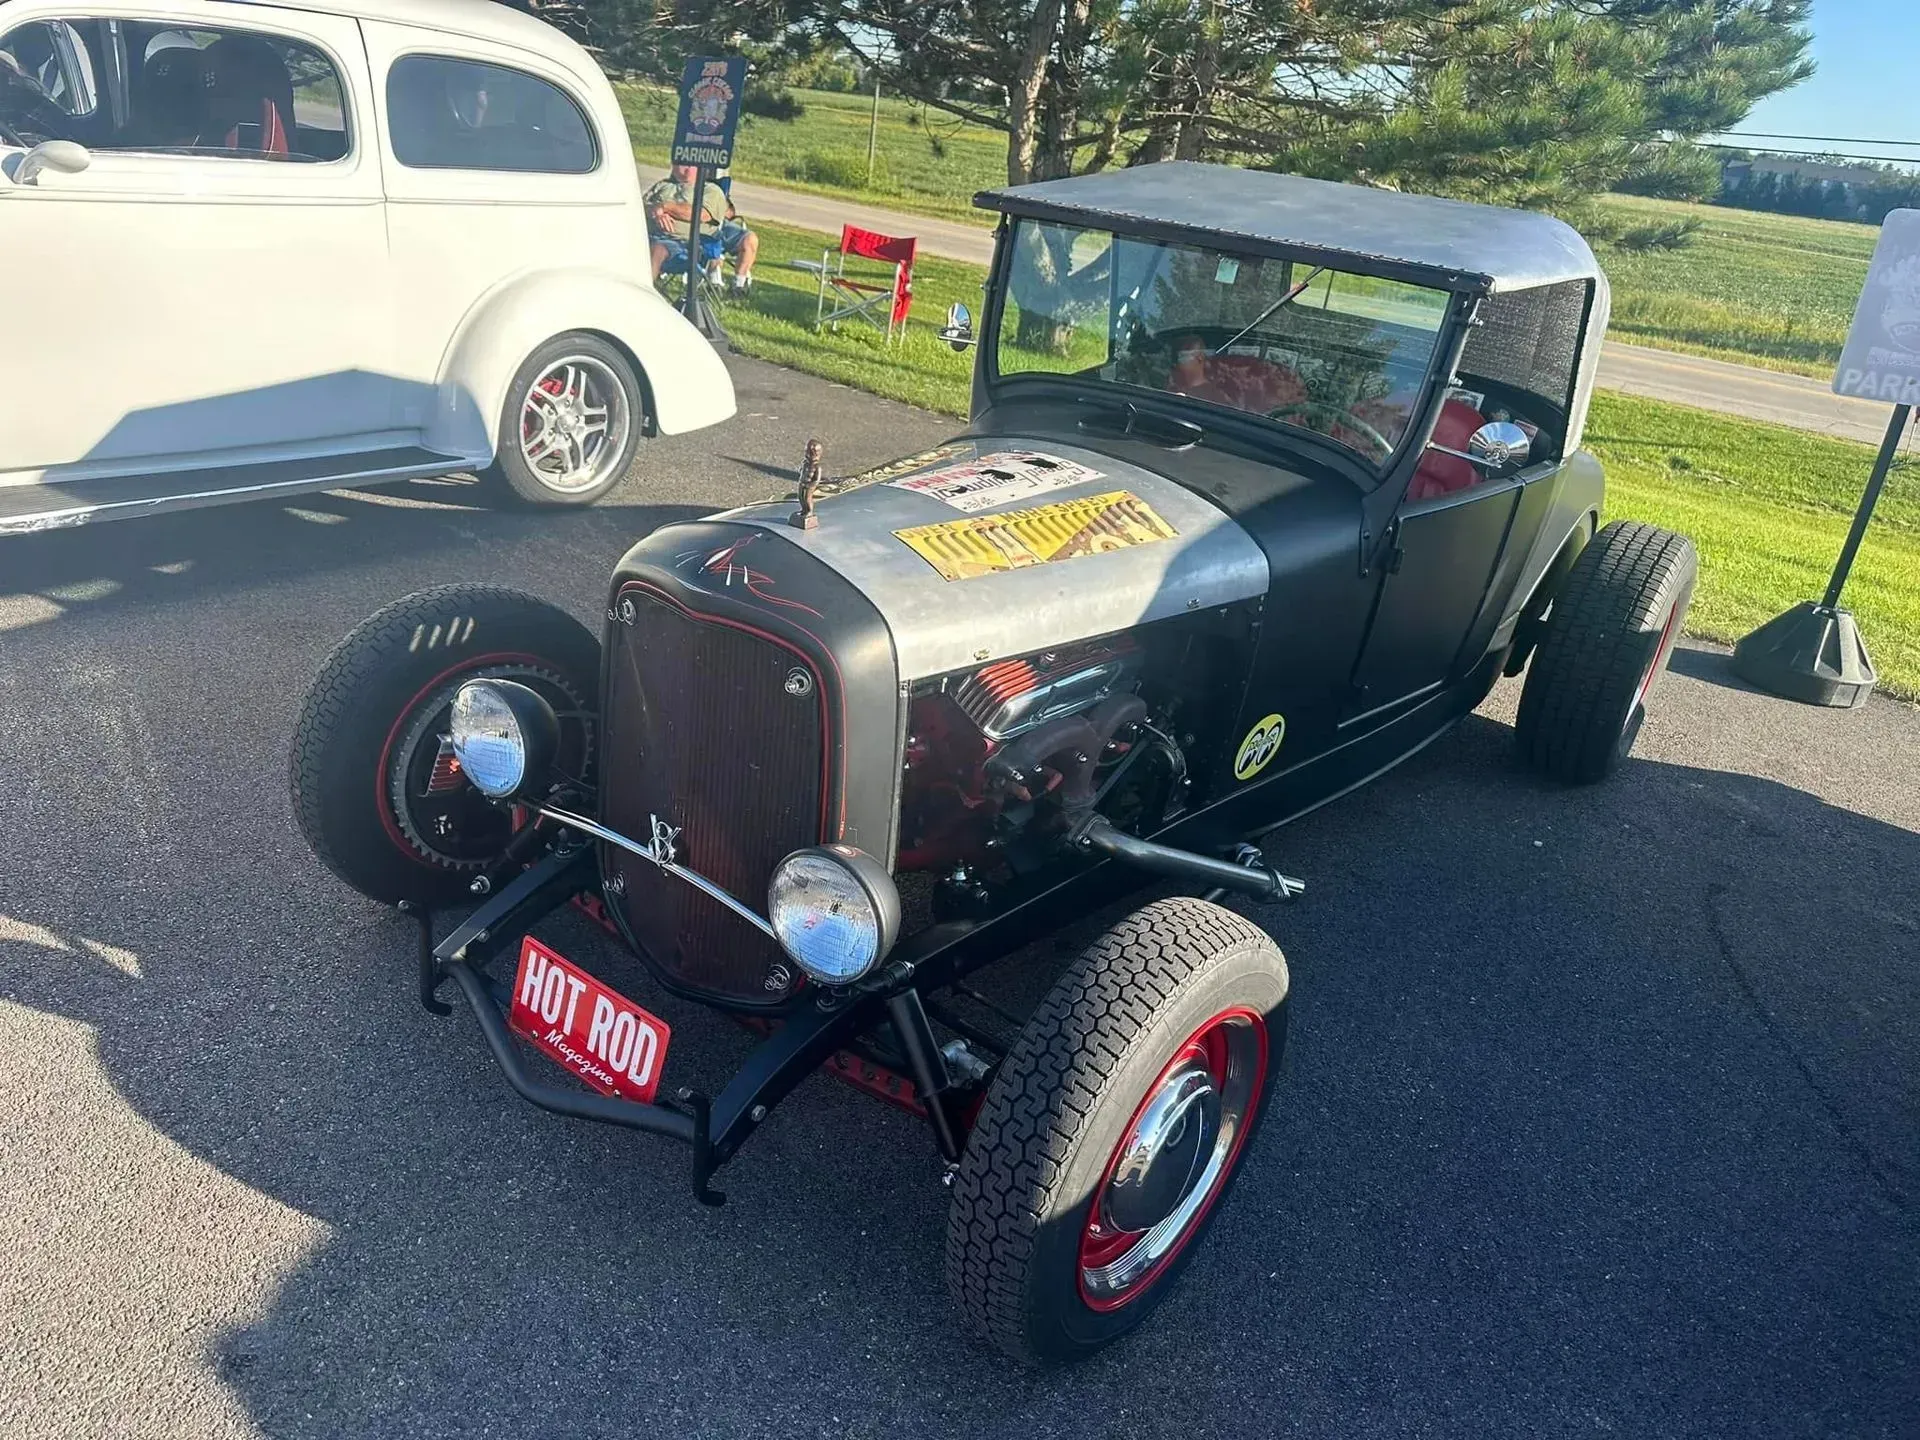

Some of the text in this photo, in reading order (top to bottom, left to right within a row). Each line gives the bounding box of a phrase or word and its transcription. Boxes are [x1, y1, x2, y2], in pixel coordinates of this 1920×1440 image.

[674, 147, 728, 164] PARKING
[520, 950, 658, 1087] HOT ROD
[544, 1029, 614, 1086] Magazine
